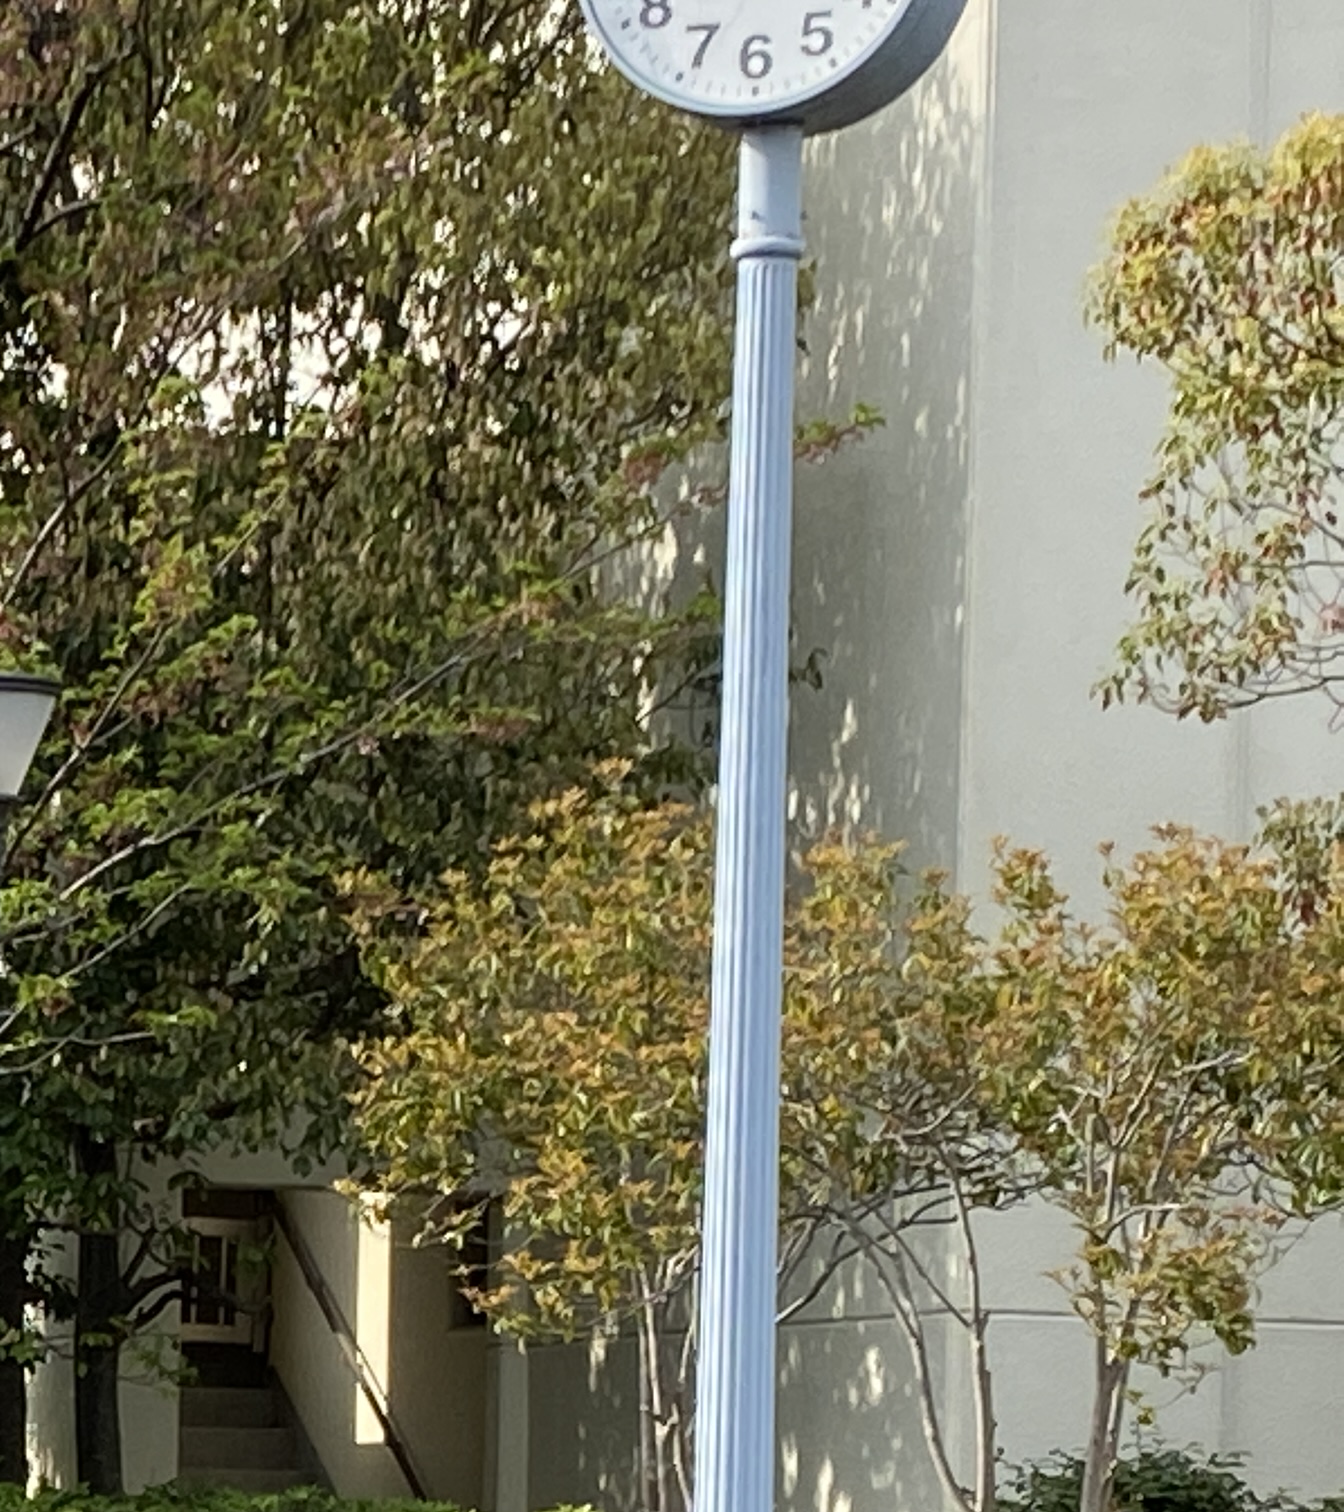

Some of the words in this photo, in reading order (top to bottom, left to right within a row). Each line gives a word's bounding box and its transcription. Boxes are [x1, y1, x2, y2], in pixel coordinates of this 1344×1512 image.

[640, 0, 672, 29] 8
[801, 10, 833, 56] 5
[686, 22, 720, 69] 7
[740, 34, 773, 79] 6
